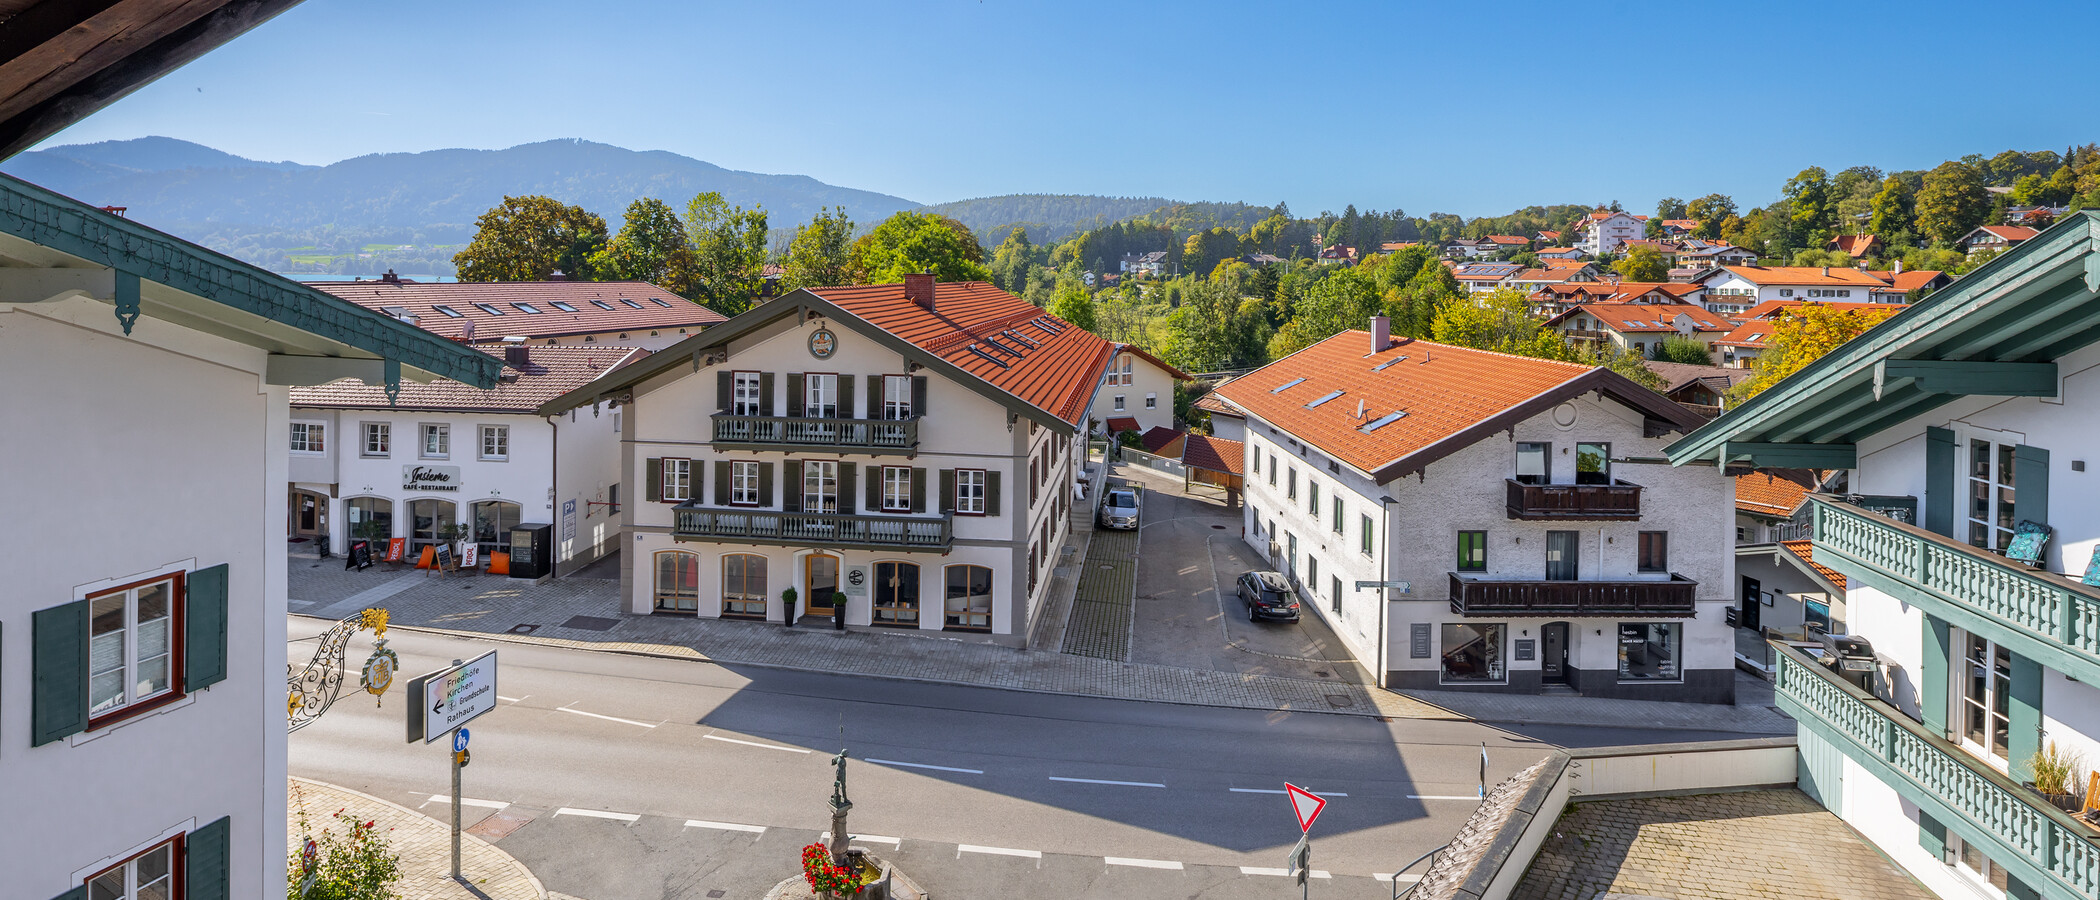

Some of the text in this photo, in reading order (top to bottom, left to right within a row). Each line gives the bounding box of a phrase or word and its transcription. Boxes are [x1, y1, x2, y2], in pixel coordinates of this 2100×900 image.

[410, 466, 450, 484] Insieme
[564, 503, 570, 514] P
[447, 668, 479, 688] Friedhöfe
[447, 681, 474, 699] Kirchen
[460, 685, 489, 704] Grundschule
[447, 705, 474, 724] Rathaus
